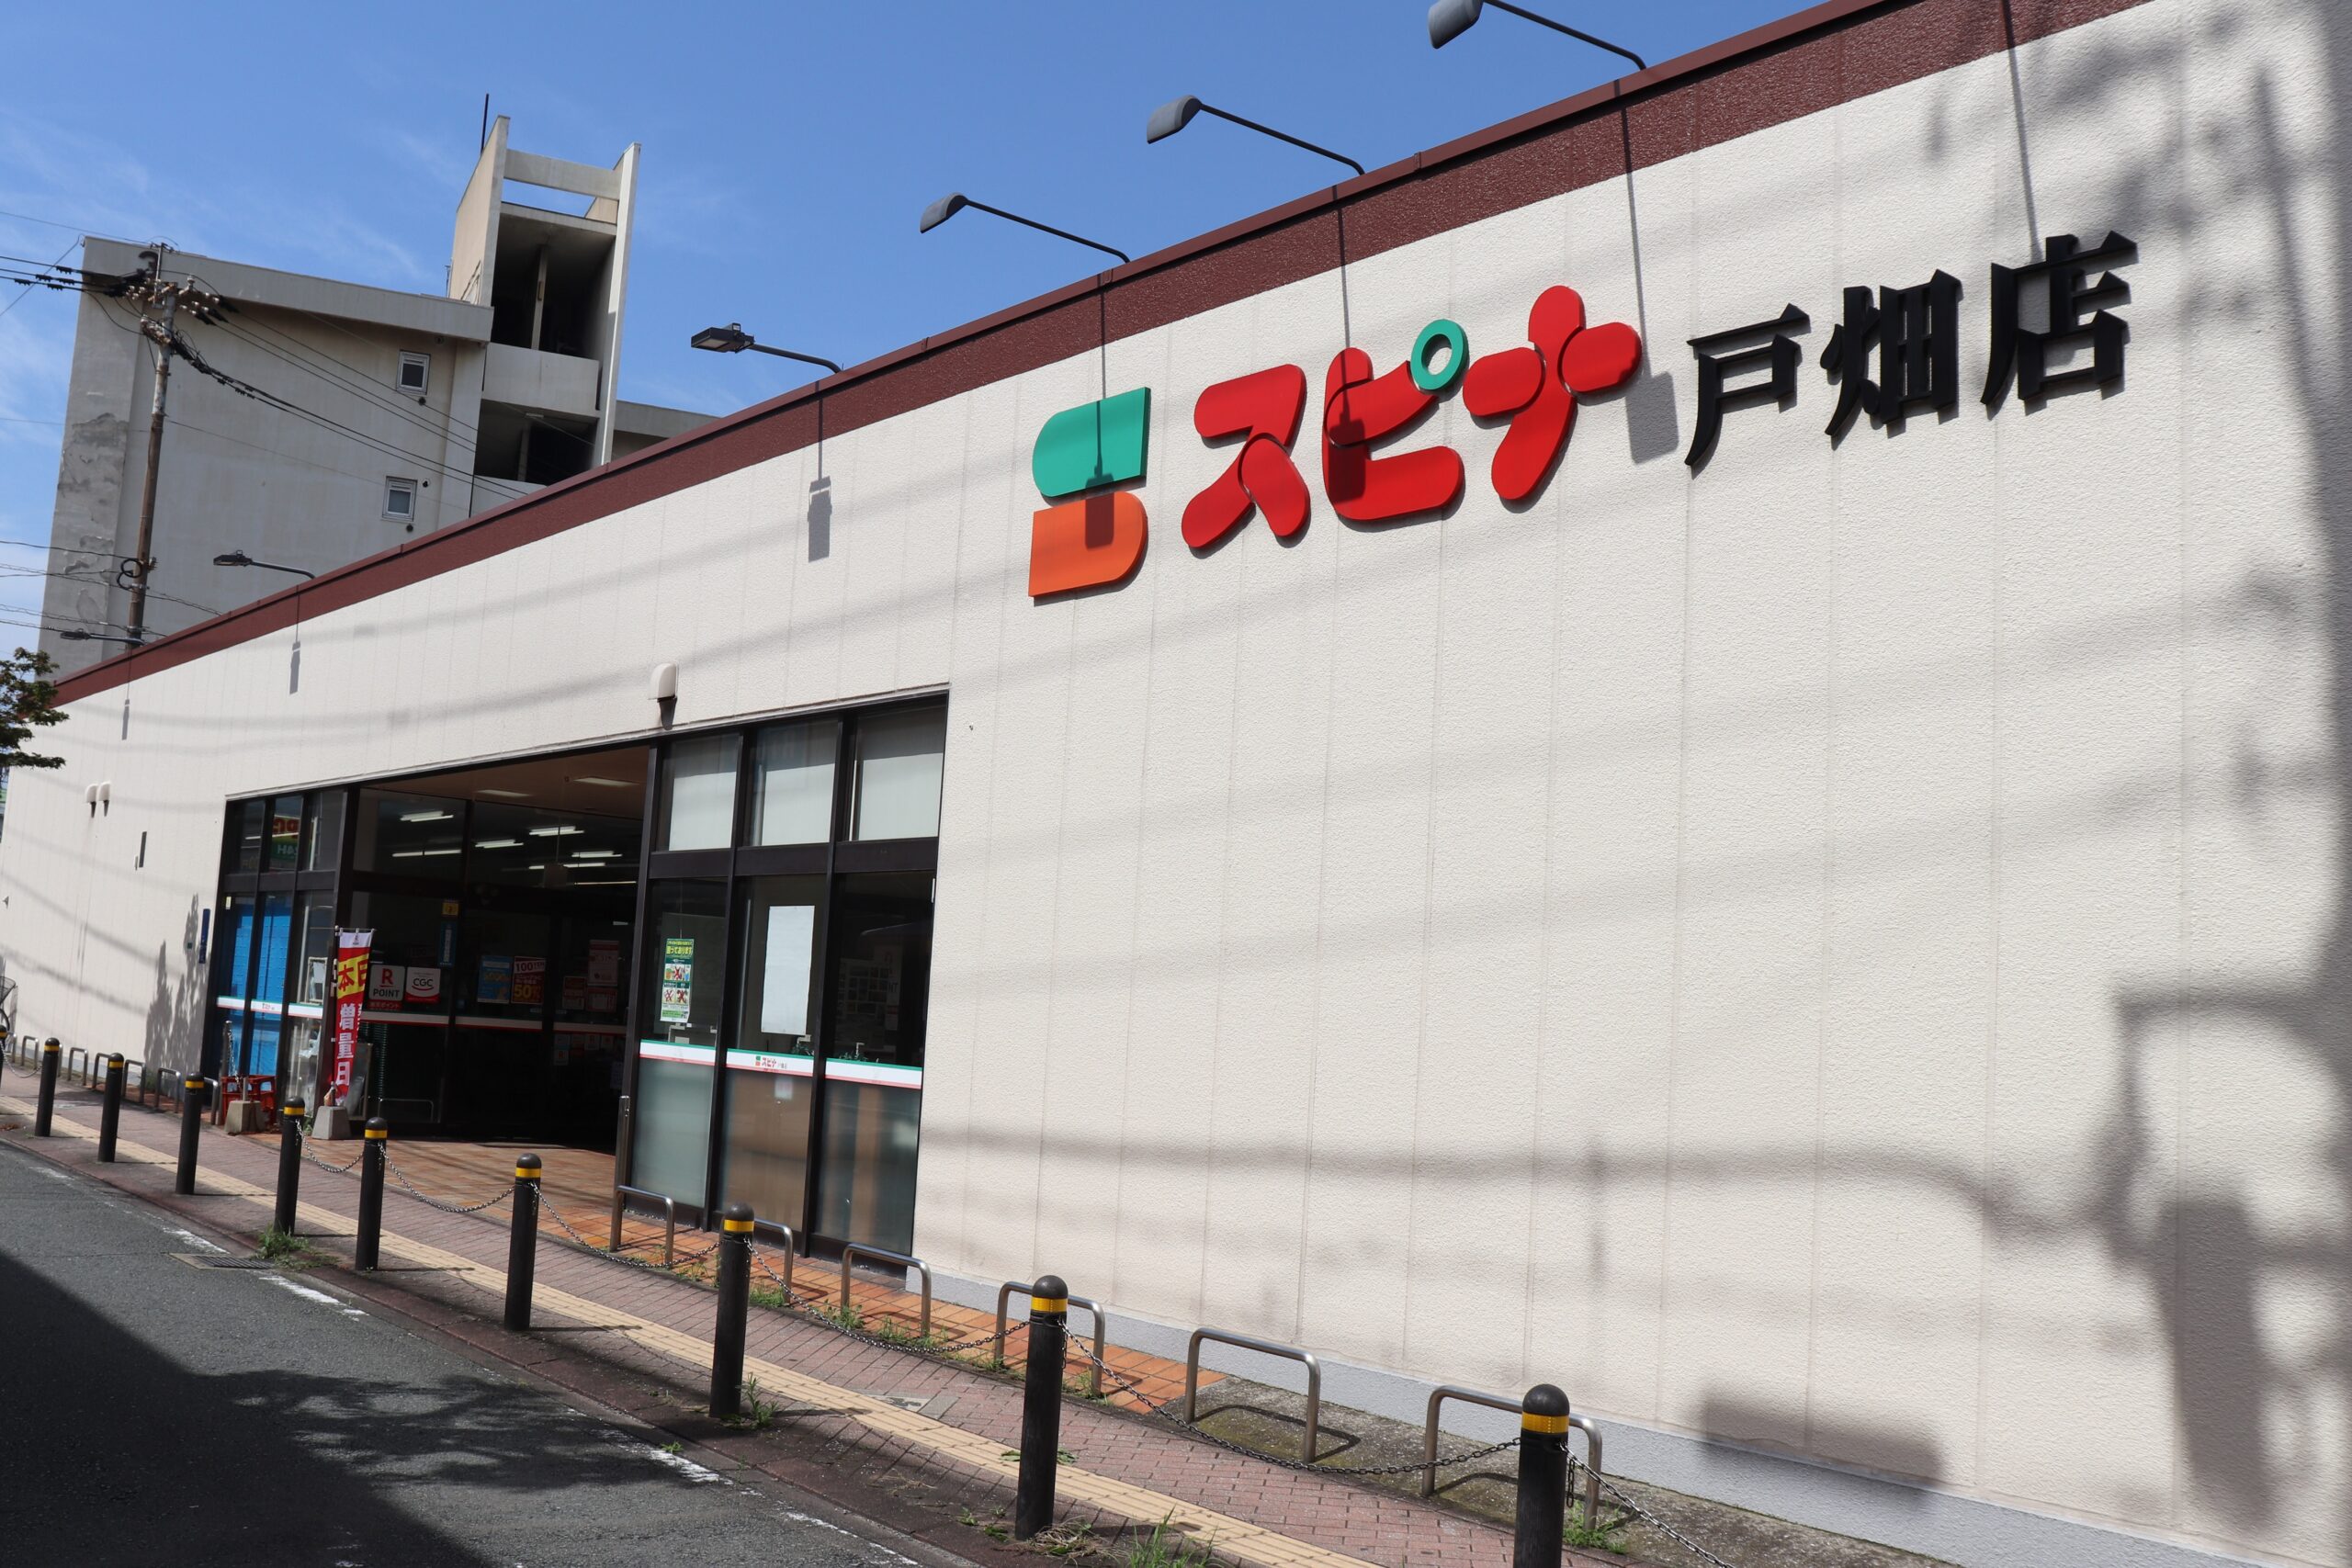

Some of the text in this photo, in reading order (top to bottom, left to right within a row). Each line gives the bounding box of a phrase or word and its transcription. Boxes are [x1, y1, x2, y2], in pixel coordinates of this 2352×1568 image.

[1182, 230, 2138, 550] スピナ 戸畑店
[338, 958, 368, 992] 本日
[381, 968, 394, 986] R
[413, 977, 434, 987] CGC
[373, 987, 401, 998] POINT
